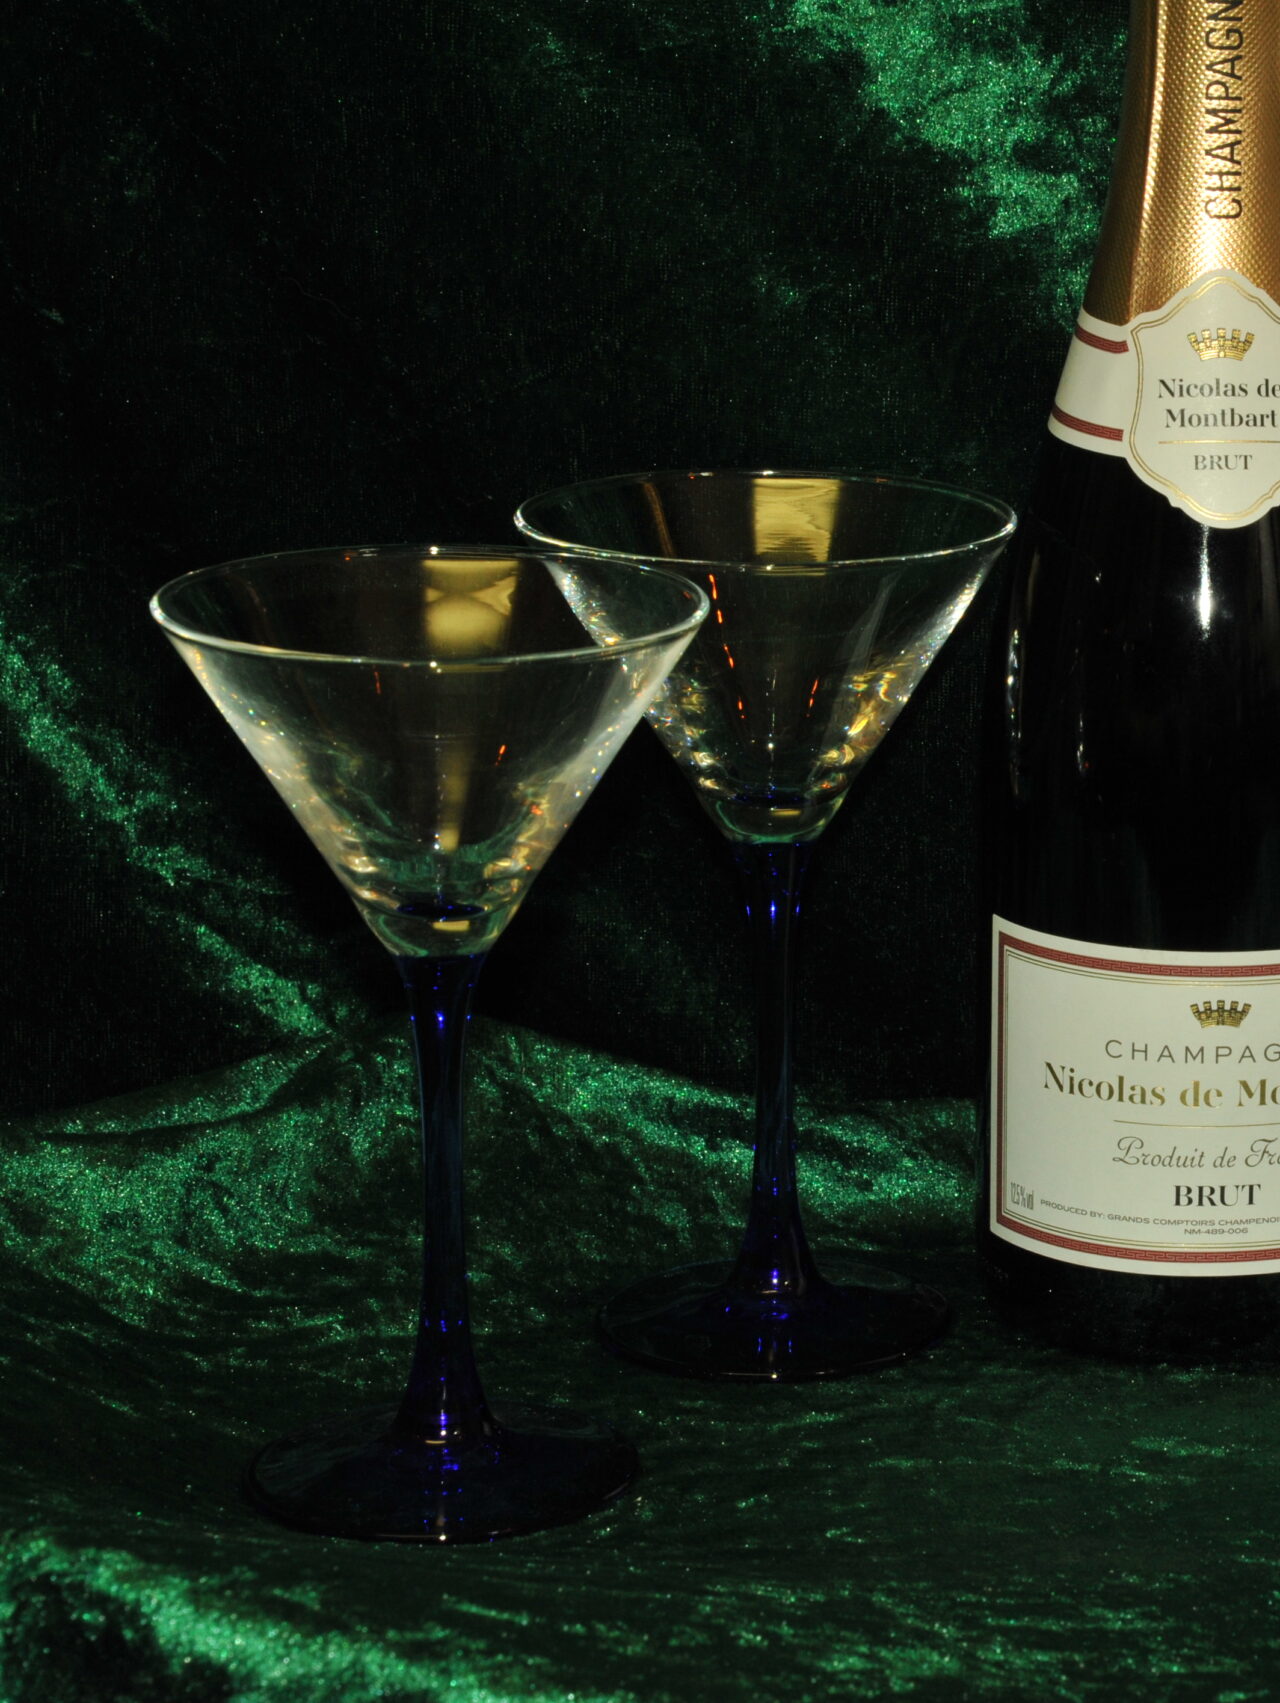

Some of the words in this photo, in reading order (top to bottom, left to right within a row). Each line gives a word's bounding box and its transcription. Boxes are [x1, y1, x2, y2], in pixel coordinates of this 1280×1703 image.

[1205, 0, 1243, 219] CHAMPAGN
[1158, 378, 1248, 398] Nicolas
[1165, 407, 1278, 428] Montbart
[1194, 454, 1252, 470] BRUT
[1044, 1061, 1166, 1106] Nicolas
[1179, 1080, 1223, 1108] de
[1112, 1136, 1205, 1168] Produit
[1213, 1146, 1236, 1168] de
[1174, 1184, 1261, 1207] BRUT
[1040, 1199, 1087, 1215] PRODUCED
[1090, 1211, 1105, 1219] BY:
[1107, 1213, 1150, 1224] GRANDS
[1152, 1218, 1215, 1227] COMPTOIRS
[1184, 1227, 1248, 1235] NM-489-006
